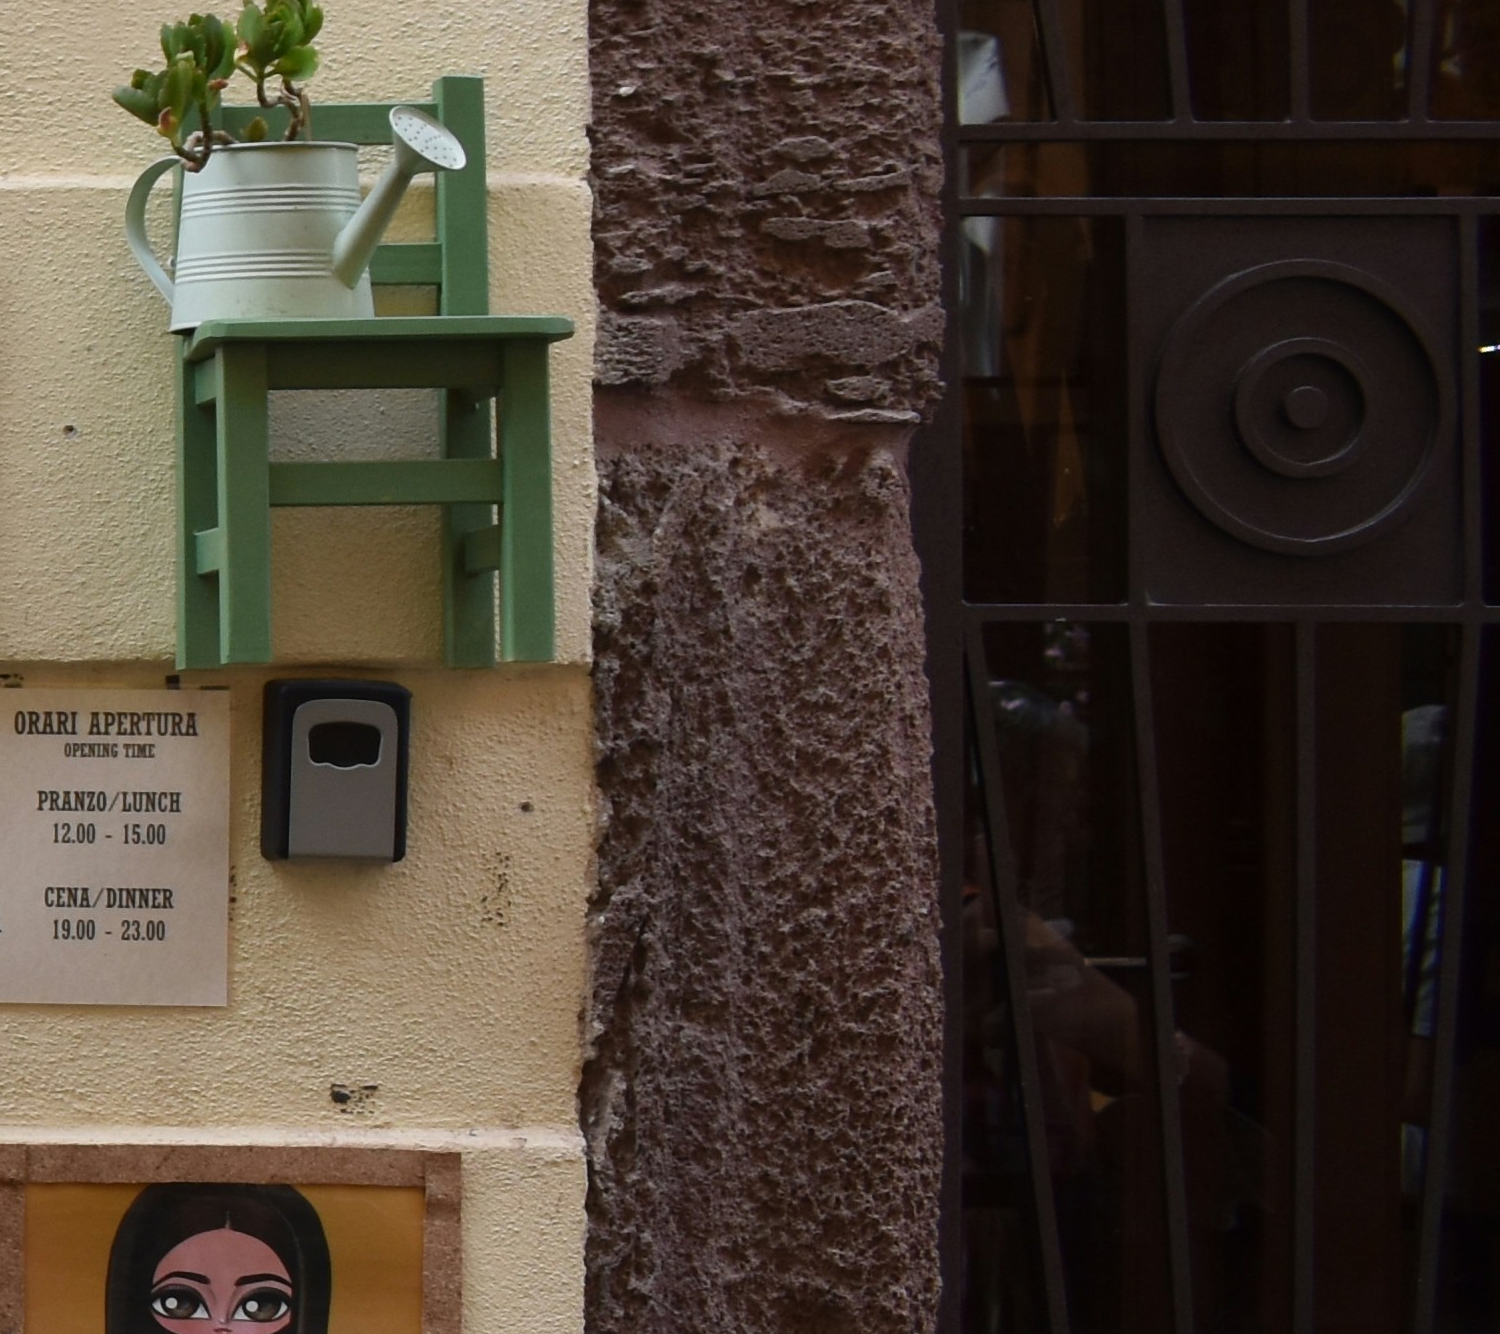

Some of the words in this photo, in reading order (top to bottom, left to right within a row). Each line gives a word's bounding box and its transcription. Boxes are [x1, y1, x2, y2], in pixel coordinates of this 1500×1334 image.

[14, 711, 78, 736] ORARI
[88, 712, 198, 737] APERTURA
[64, 743, 119, 759] OPENING
[123, 743, 156, 759] TIME
[37, 791, 182, 814] PRANZO/LUNCH
[53, 823, 96, 845] 12.00
[123, 823, 167, 845] 15.00
[44, 887, 175, 910] CENA/DINNER
[53, 919, 96, 941] 19.00
[121, 920, 166, 942] 23.00
